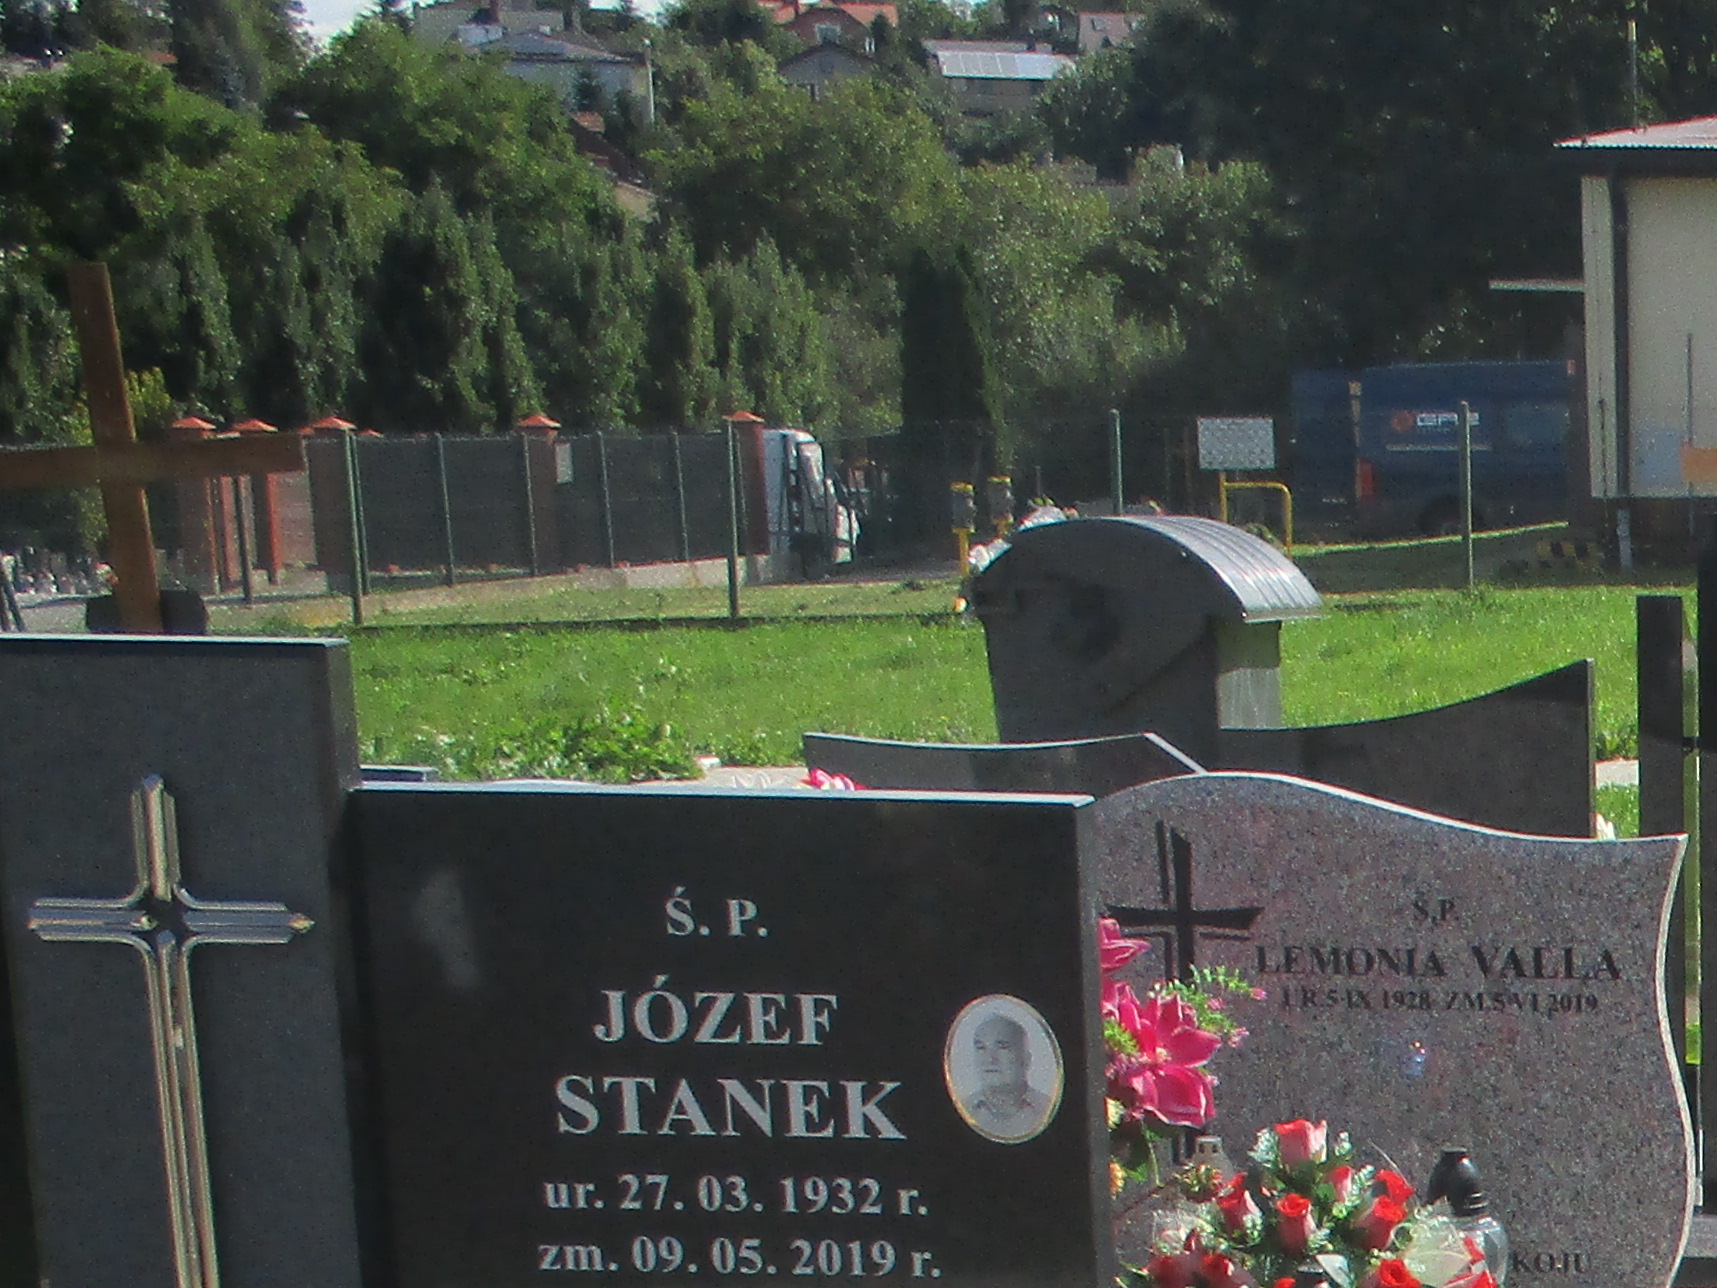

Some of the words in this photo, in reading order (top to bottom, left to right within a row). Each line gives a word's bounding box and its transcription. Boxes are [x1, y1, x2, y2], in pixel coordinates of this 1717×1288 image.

[664, 885, 711, 937] Ś.
[725, 898, 769, 937] P.
[1255, 945, 1447, 977] LEMONIA
[1471, 945, 1621, 980] VALLA
[592, 974, 839, 1046] JÓZEF
[554, 1074, 908, 1141] STANEK
[543, 1178, 605, 1211] ur.
[617, 1172, 684, 1211] 27.
[696, 1174, 764, 1213] 03.
[780, 1176, 883, 1215] 1932
[896, 1186, 929, 1216] r.
[538, 1242, 620, 1272] zm.
[630, 1235, 698, 1274] 09.
[710, 1237, 778, 1275] 05.
[789, 1239, 897, 1277] 2019
[910, 1248, 943, 1279] r.
